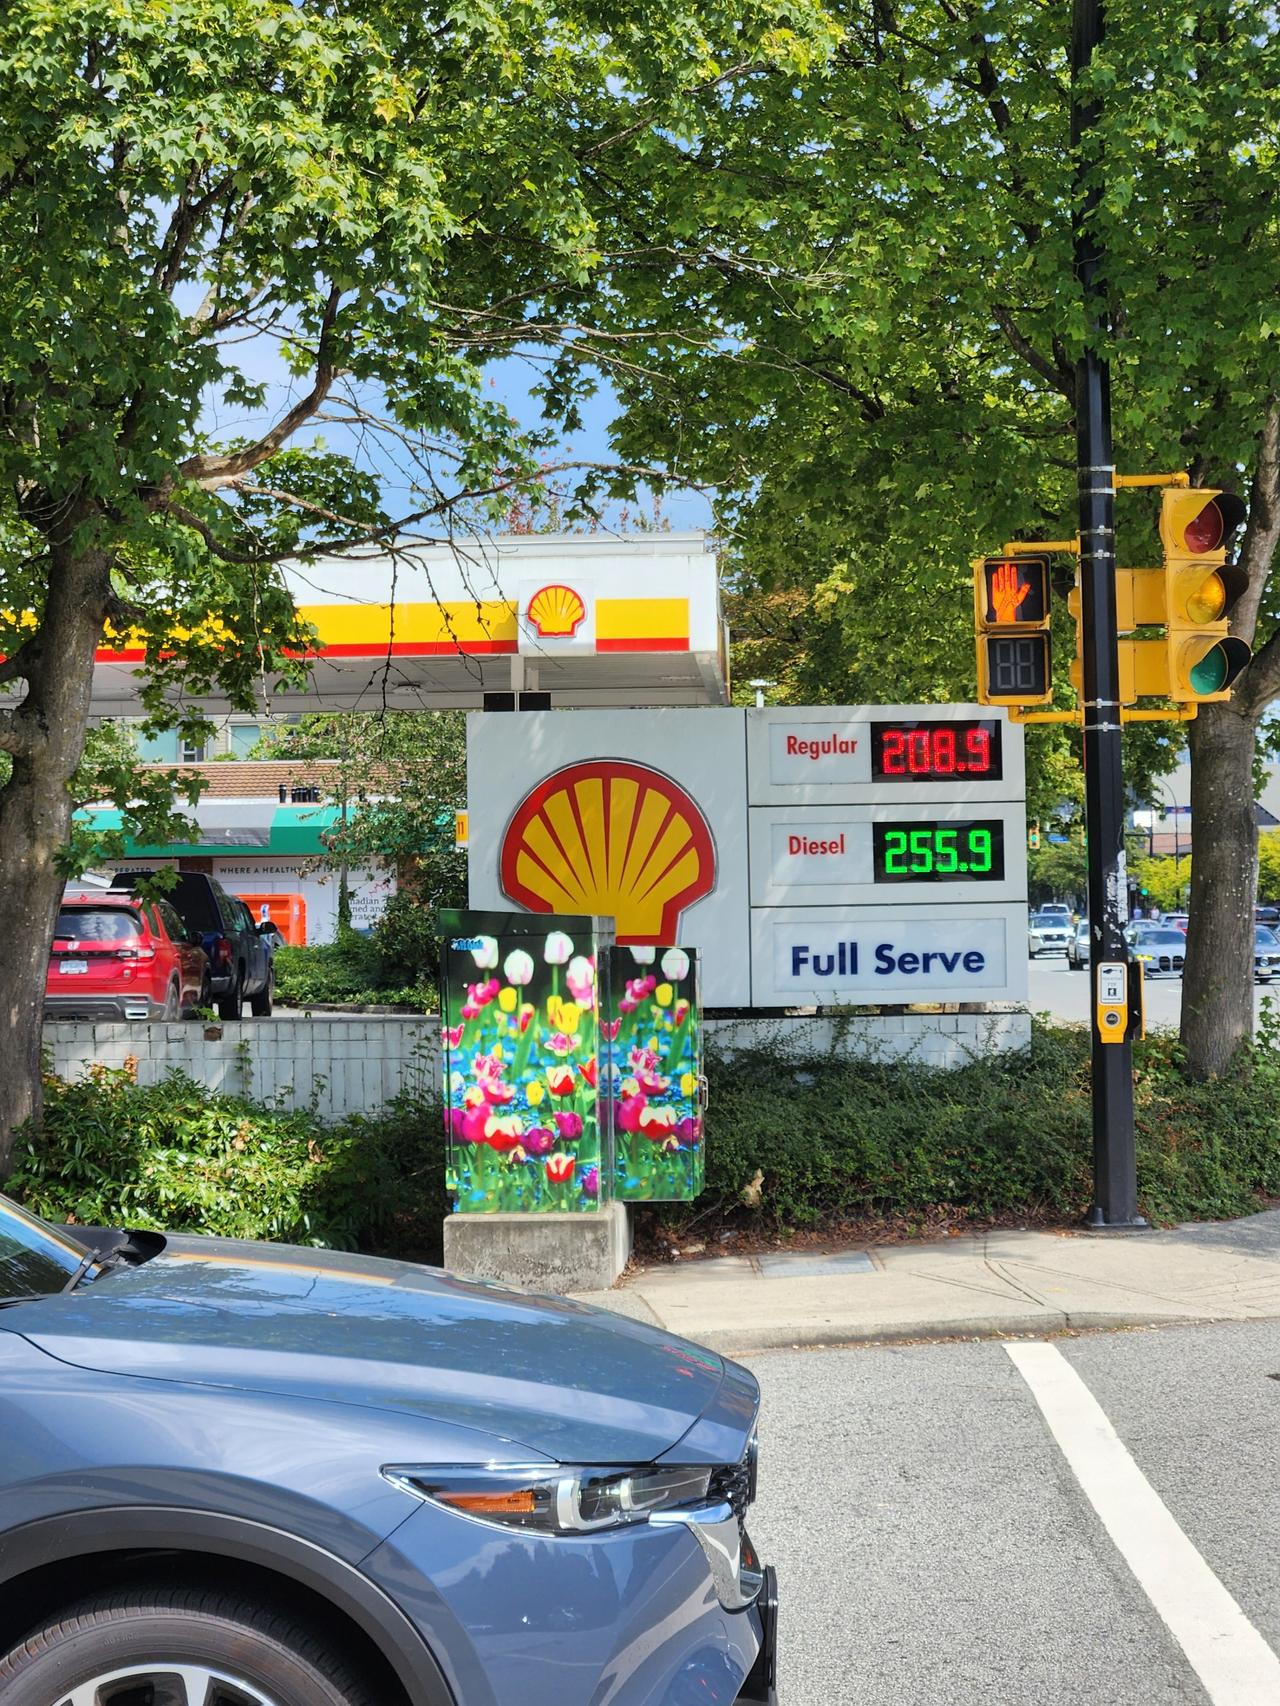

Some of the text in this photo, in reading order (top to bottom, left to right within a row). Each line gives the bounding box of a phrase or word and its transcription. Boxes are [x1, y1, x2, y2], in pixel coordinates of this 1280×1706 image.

[786, 729, 990, 775] Regular 208.9
[788, 830, 991, 874] Diesel 255.9
[792, 942, 985, 976] Full Serve
